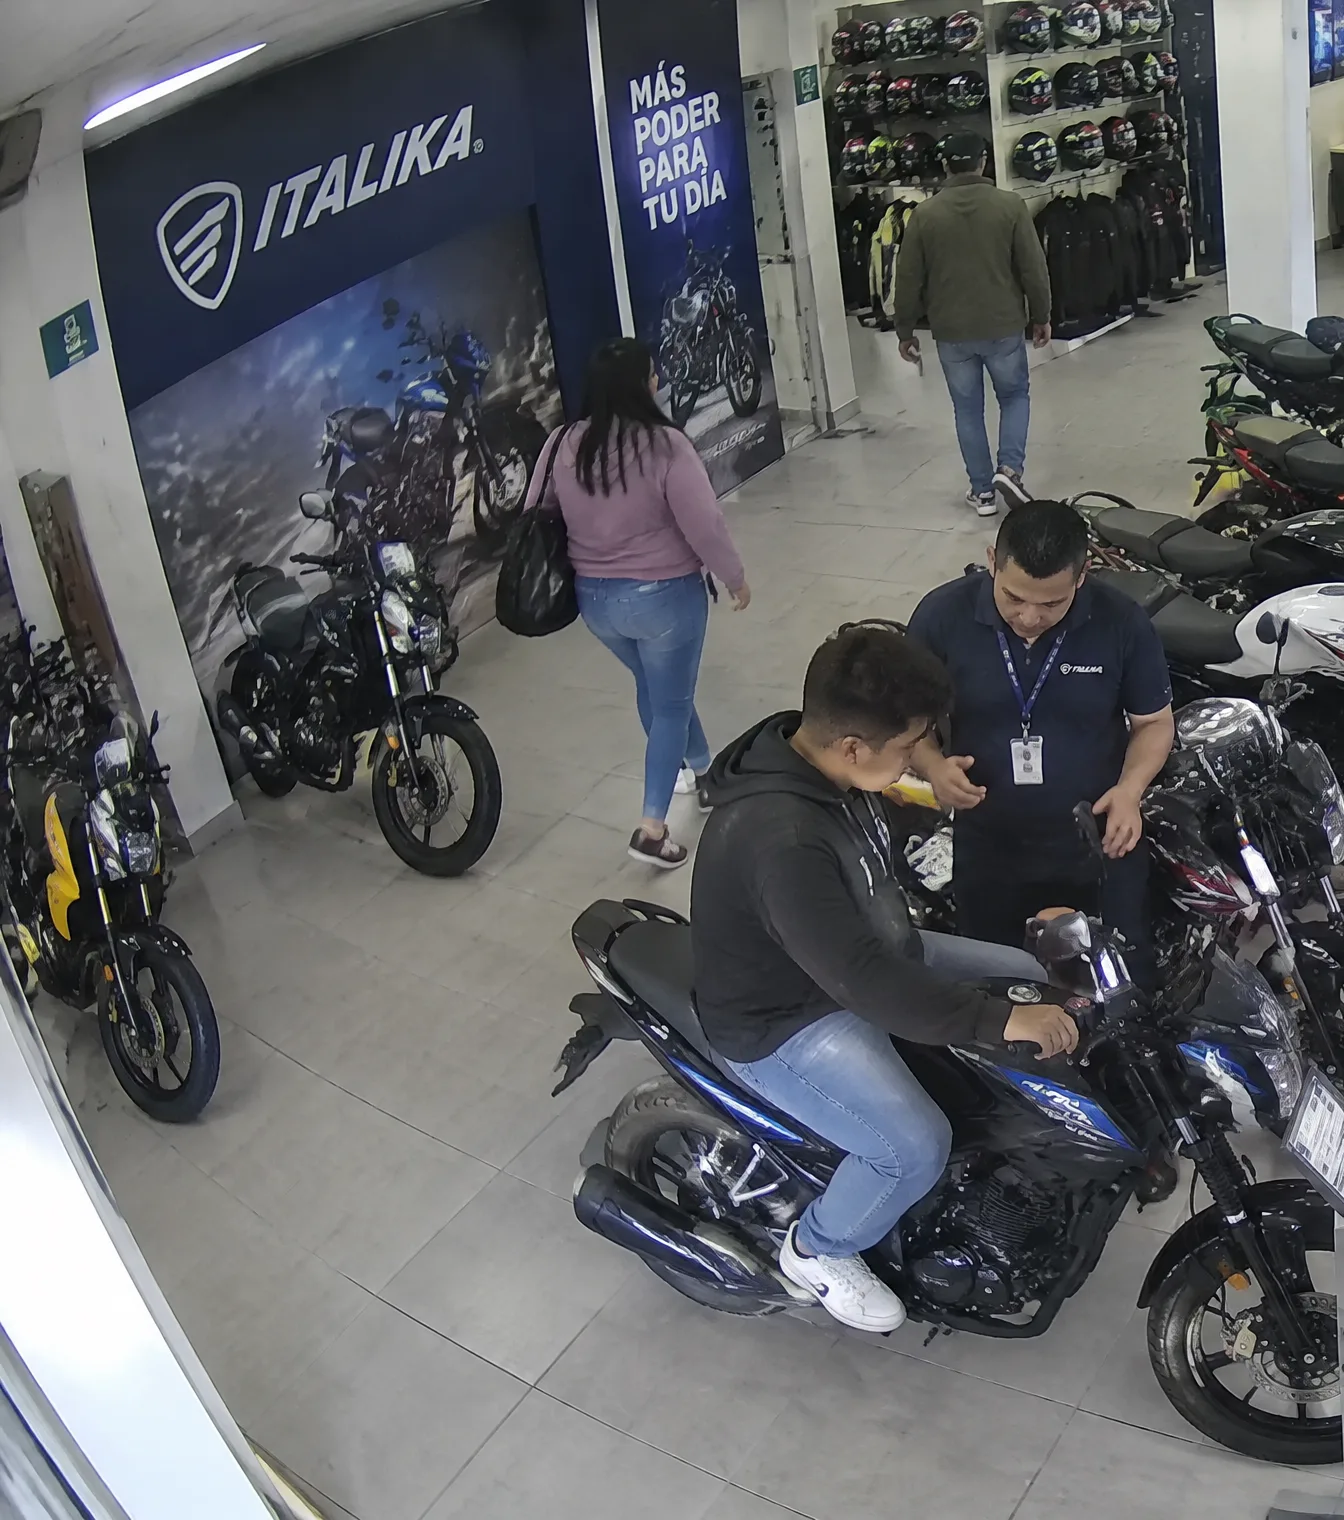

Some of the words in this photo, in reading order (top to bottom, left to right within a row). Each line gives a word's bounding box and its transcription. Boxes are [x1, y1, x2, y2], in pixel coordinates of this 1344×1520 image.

[629, 60, 687, 114] MÁS
[634, 92, 721, 155] PODER
[253, 105, 474, 252] ITALIKA
[639, 136, 708, 193] PARA
[643, 188, 679, 231] TU
[684, 167, 727, 215] DÍA
